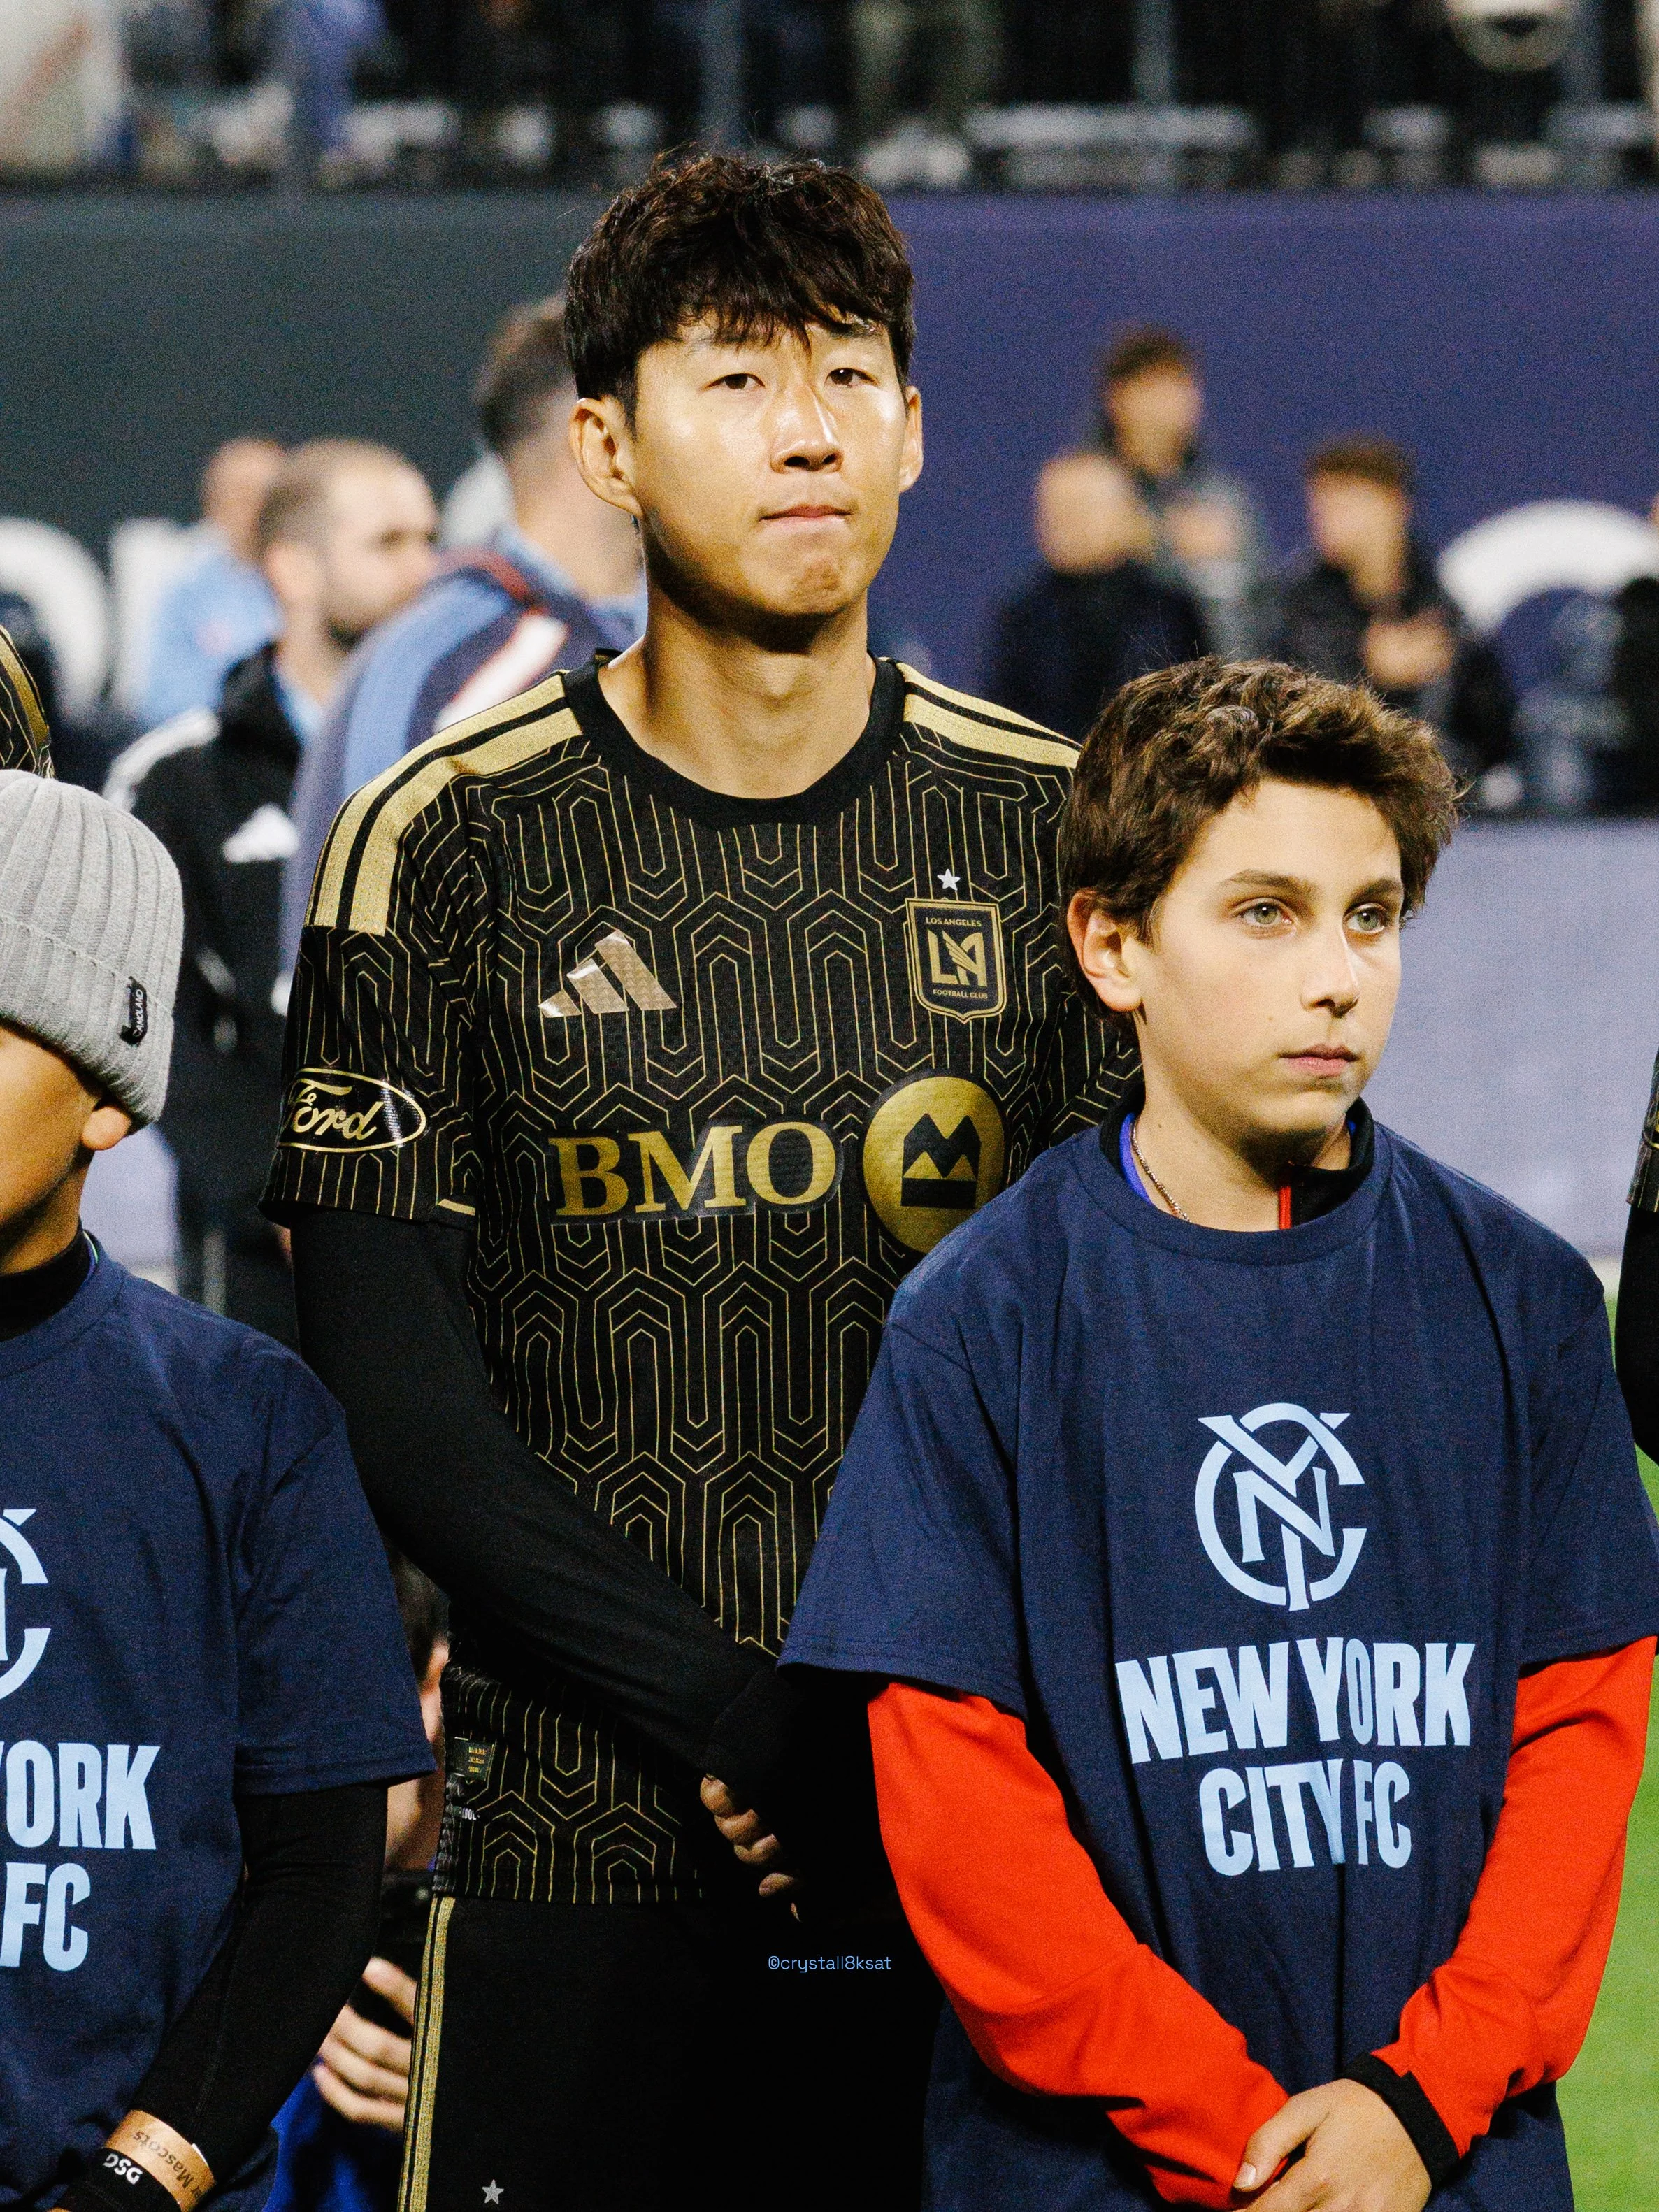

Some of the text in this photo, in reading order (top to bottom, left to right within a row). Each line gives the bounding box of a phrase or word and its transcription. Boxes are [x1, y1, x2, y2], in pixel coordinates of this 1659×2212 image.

[926, 917, 982, 927] LOS ANGELES
[933, 989, 968, 998] FOOTBALL
[289, 1078, 385, 1140] Ford
[548, 1121, 837, 1216] BMO
[1115, 1637, 1476, 1764] NEW YORK
[0, 1740, 161, 1850] ORK
[1199, 1758, 1412, 1876] CITY FC
[0, 1862, 91, 1972] FC
[103, 2153, 143, 2185] DSG
[133, 2131, 195, 2189] Mascots
